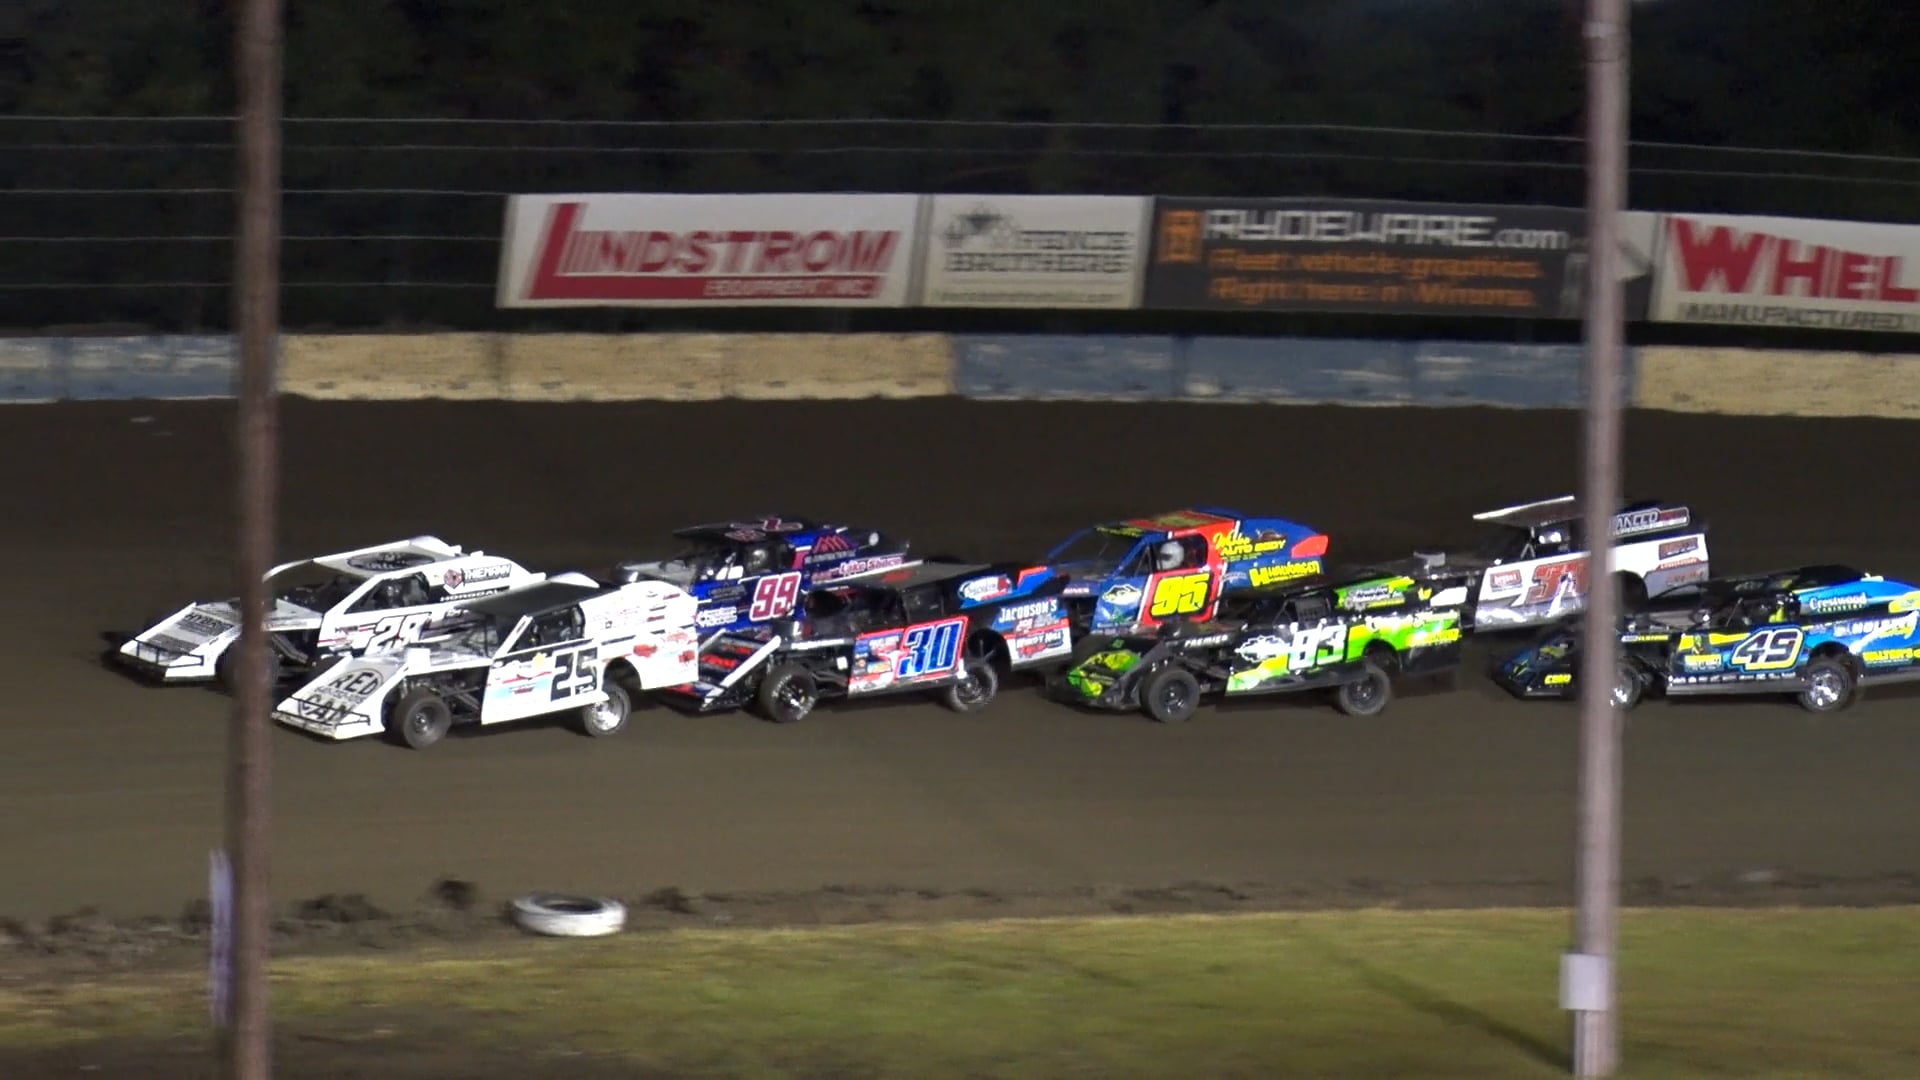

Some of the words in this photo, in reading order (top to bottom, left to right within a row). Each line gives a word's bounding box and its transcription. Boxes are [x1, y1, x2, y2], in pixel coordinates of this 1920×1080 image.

[525, 203, 898, 300] LINDSTROM
[1220, 543, 1253, 556] AUTO
[751, 572, 800, 621] 99
[1151, 573, 1211, 617] 95
[1809, 592, 1867, 610] Crestwood
[897, 618, 965, 680] 30
[1732, 629, 1802, 669] 49
[327, 671, 380, 696] RED
[550, 646, 598, 702] 25
